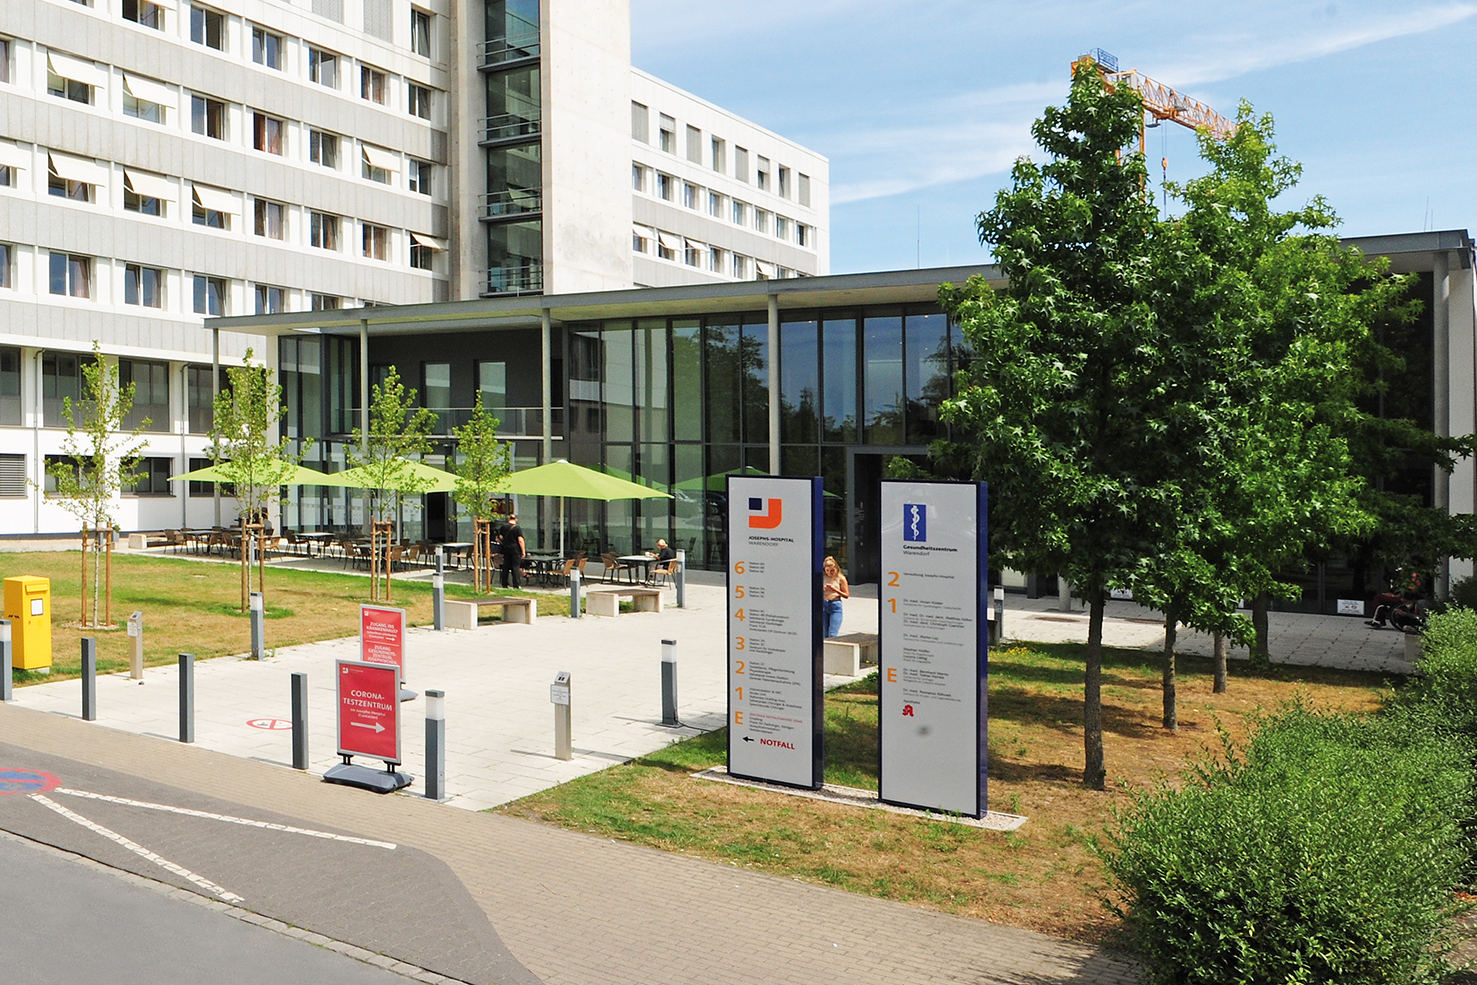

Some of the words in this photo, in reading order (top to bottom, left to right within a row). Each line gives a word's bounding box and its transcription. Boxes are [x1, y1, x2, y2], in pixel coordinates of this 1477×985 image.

[734, 561, 745, 574] 6
[888, 571, 900, 587] 2
[735, 585, 745, 599] 5
[888, 598, 896, 613] 1
[734, 608, 746, 621] 4
[735, 636, 745, 650] 3
[735, 660, 745, 674] 2
[887, 668, 897, 682] E
[351, 690, 385, 700] CORONA-
[735, 687, 743, 700] 1
[343, 697, 392, 711] TESTZENTRUM
[734, 711, 743, 725] E
[760, 738, 795, 750] NOTFALL
